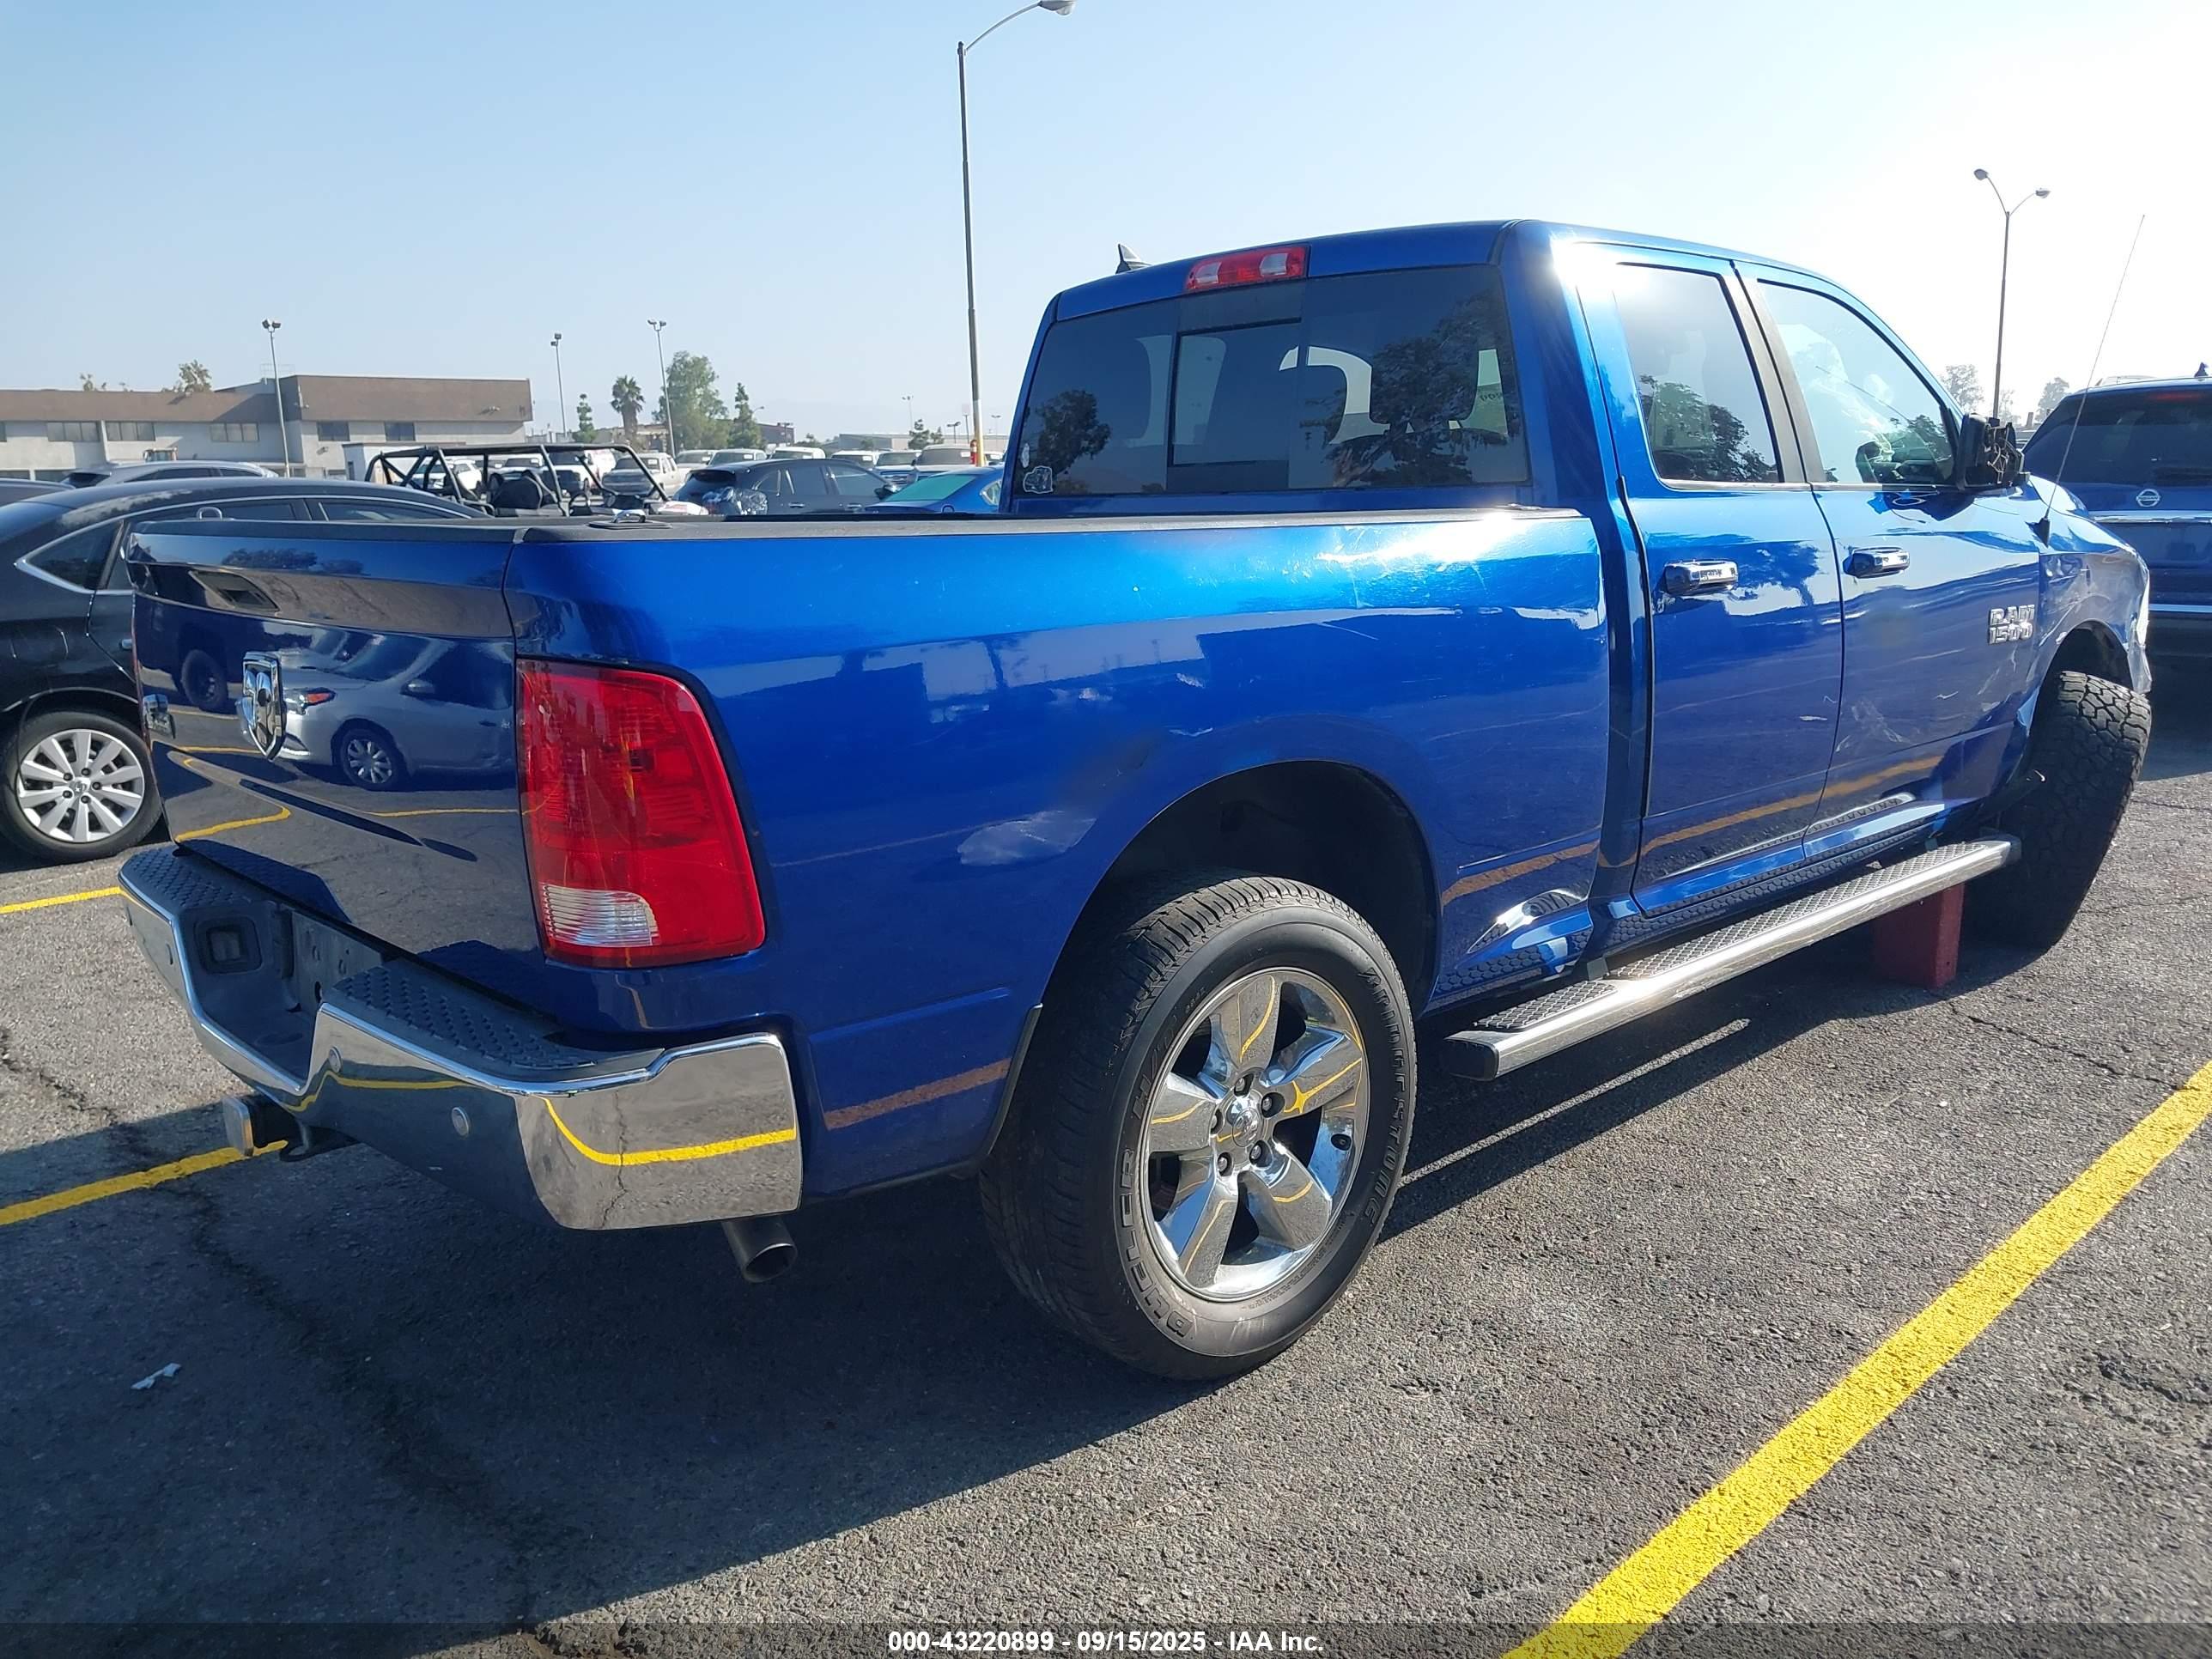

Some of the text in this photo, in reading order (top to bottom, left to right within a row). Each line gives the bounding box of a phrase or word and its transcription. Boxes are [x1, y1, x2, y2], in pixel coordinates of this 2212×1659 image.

[1989, 605, 2035, 626] RAM
[1988, 623, 2033, 645] 1500
[1121, 1148, 1194, 1338] DUELER
